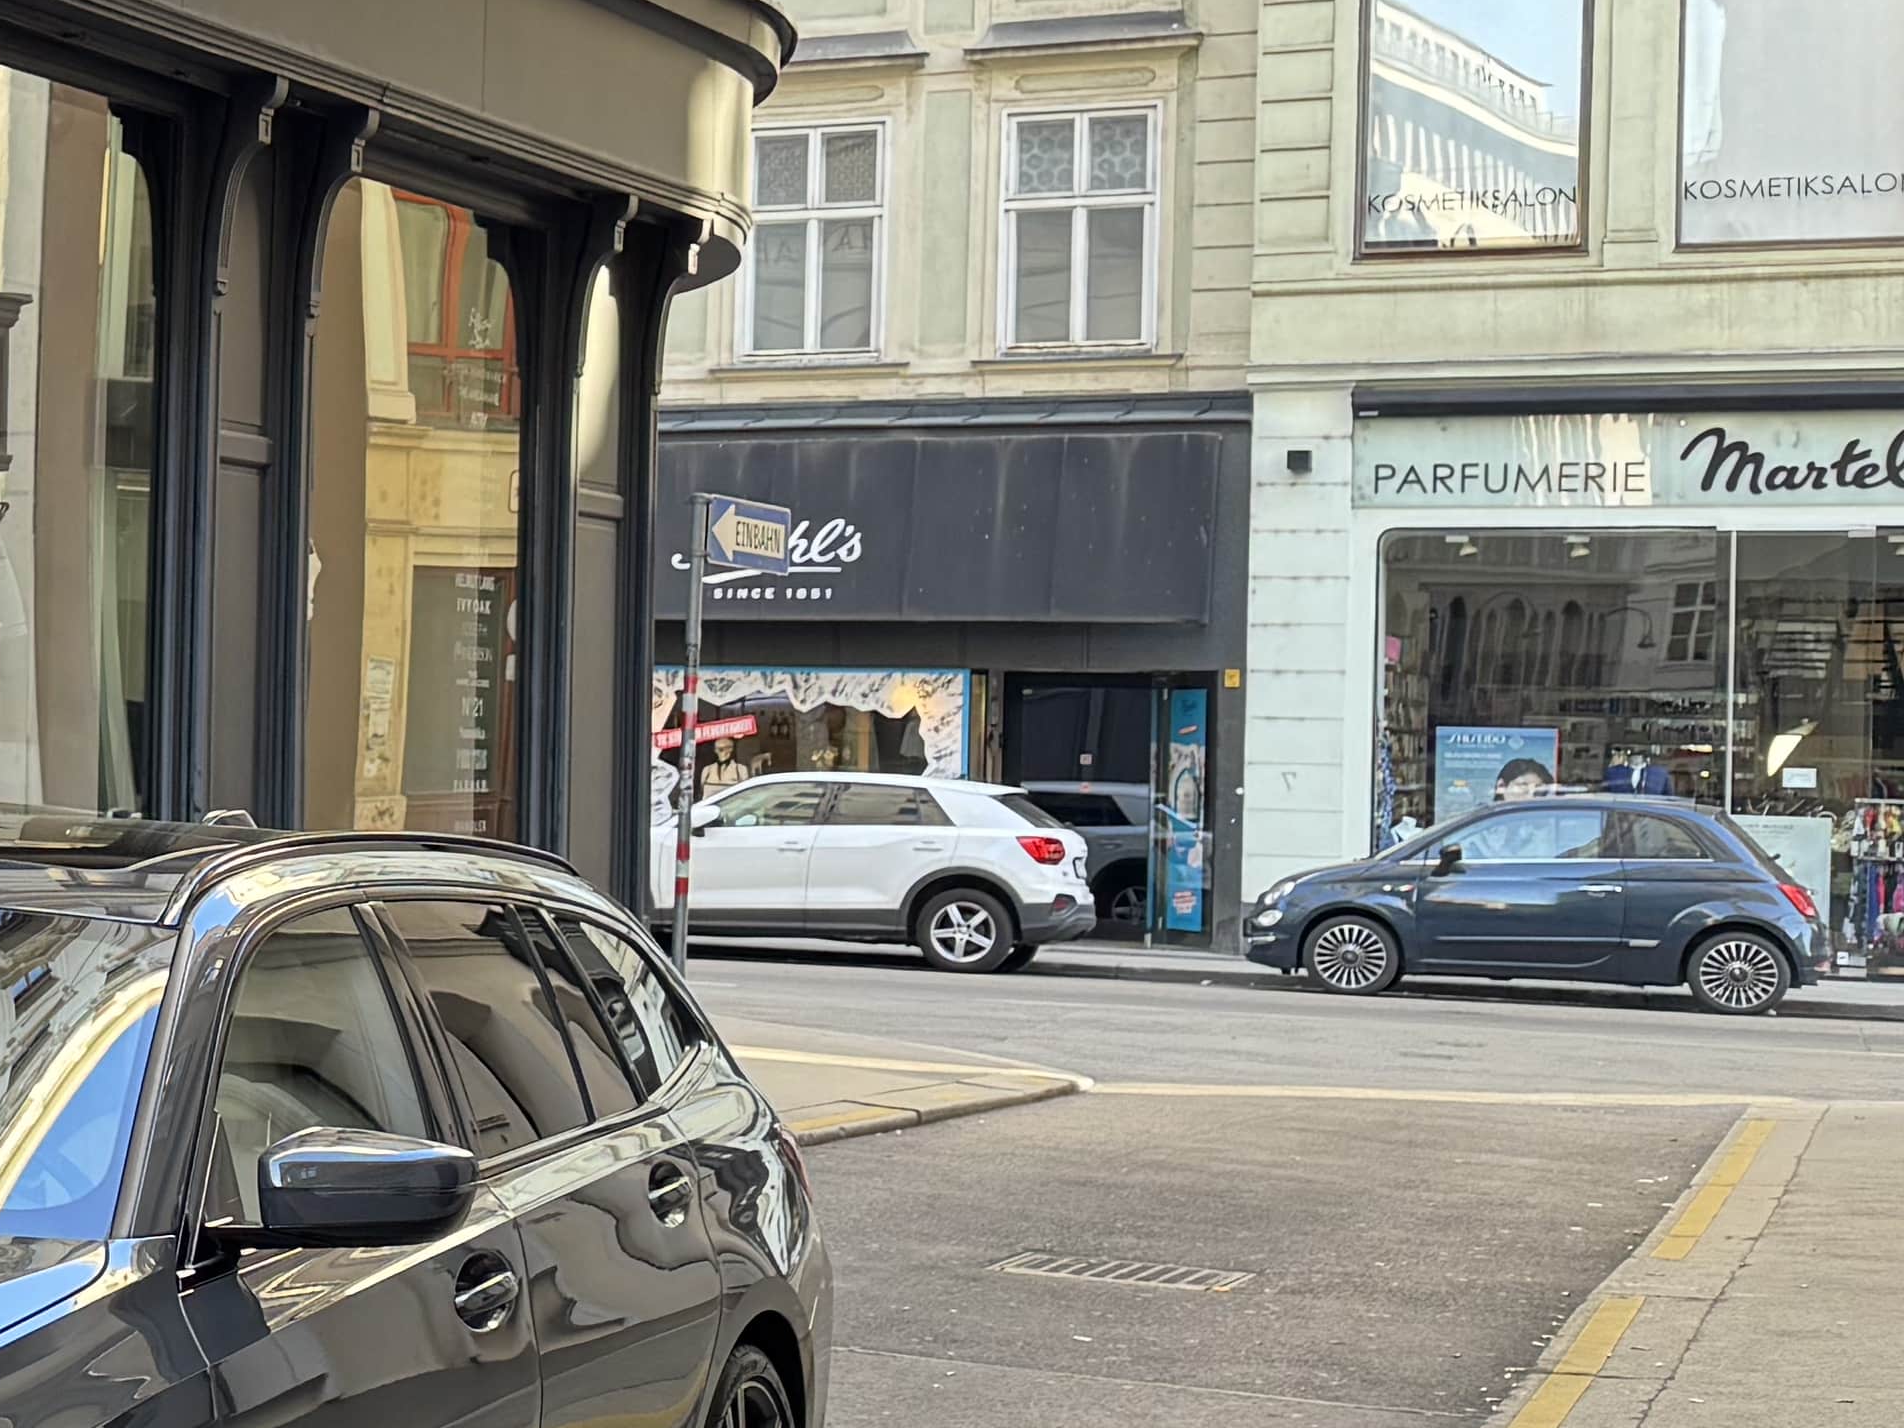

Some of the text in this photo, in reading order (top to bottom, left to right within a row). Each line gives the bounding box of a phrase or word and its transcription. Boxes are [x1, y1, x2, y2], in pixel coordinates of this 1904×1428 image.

[1367, 185, 1578, 215] KOSMETIKSALON
[1374, 461, 1646, 496] PARFUMERIE
[735, 520, 782, 555] EINBAHN
[712, 586, 776, 600] SINCE
